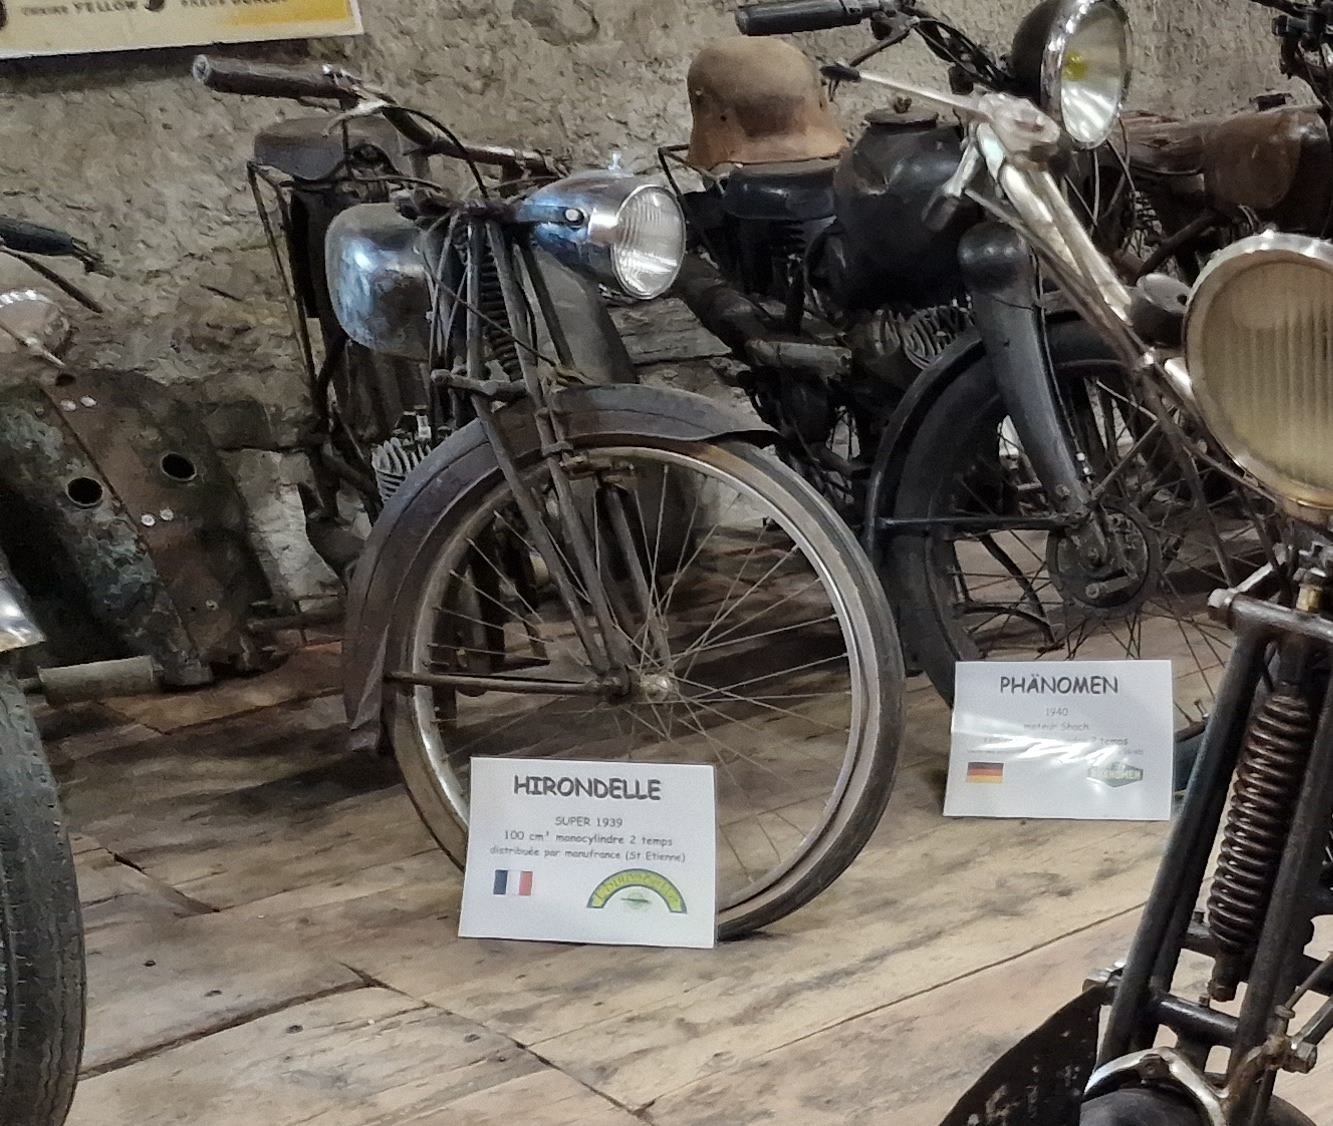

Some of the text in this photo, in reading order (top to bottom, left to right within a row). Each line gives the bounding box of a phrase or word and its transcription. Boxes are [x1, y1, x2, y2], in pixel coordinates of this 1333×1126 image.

[1000, 673, 1120, 695] PHÄNOMEN
[1045, 707, 1069, 717] 1940
[513, 775, 661, 801] HIRONDELLE
[555, 816, 623, 828] SUPER 1939
[504, 830, 525, 841] 100
[555, 833, 624, 846] monocylindre
[629, 834, 637, 845] 2
[641, 836, 673, 848] temps
[489, 845, 540, 856] distribuée
[543, 849, 561, 859] par
[564, 848, 621, 860] manufrance
